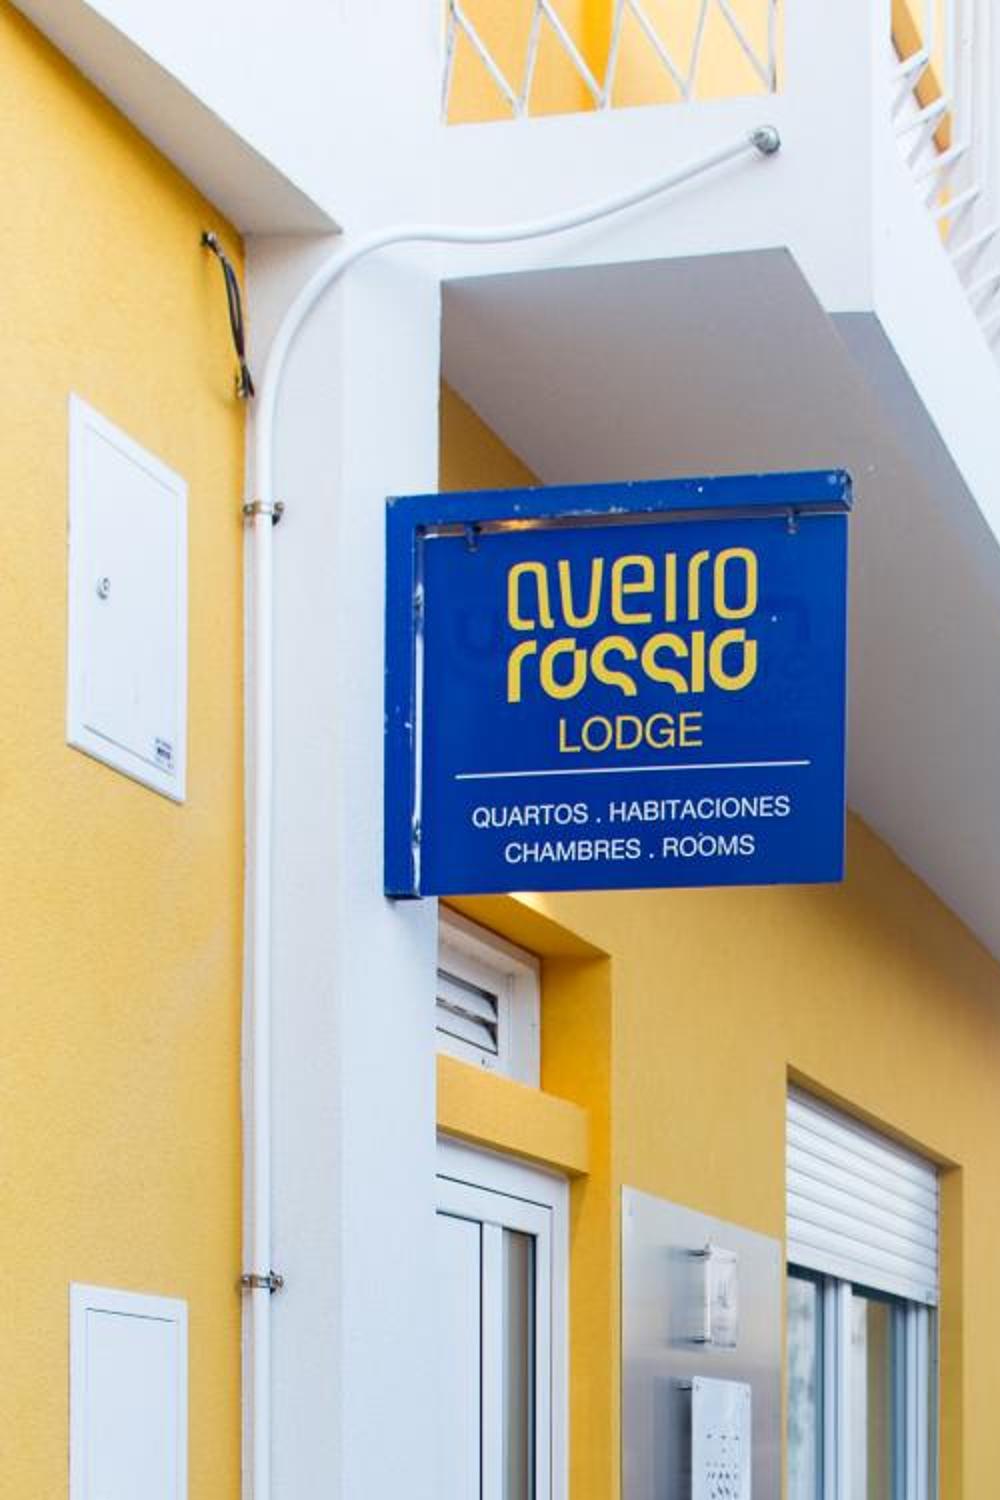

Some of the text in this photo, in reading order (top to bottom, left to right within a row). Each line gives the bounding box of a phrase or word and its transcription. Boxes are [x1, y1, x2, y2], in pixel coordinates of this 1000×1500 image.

[559, 711, 704, 753] LODGE
[471, 802, 589, 829] QUARTOS
[608, 795, 791, 822] HABITACIONES
[504, 838, 642, 864] CHAMBRES
[661, 833, 756, 858] ROOMS
